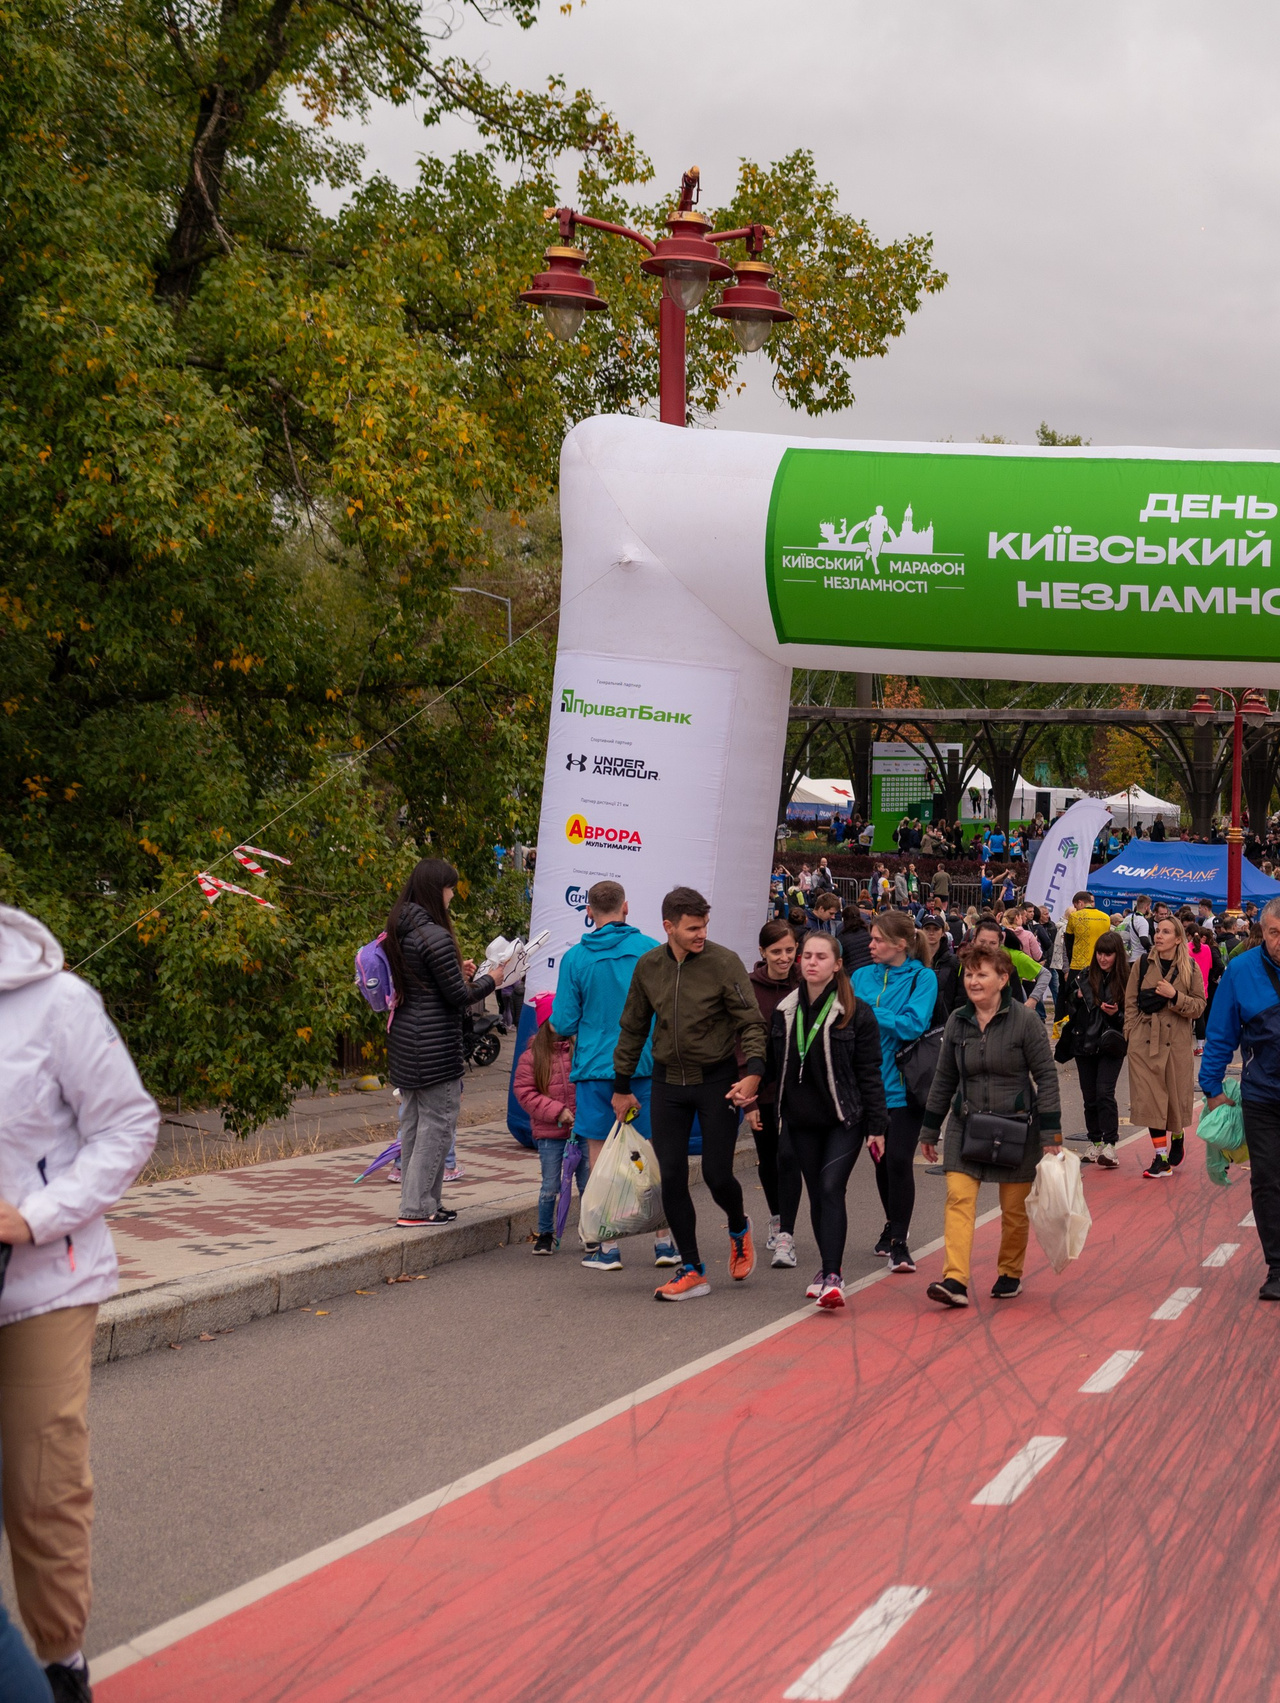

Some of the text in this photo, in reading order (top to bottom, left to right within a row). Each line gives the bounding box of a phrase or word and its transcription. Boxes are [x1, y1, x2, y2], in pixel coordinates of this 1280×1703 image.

[1139, 493, 1278, 523] ДЕНЬ
[988, 525, 1271, 567] КИЇВСЬКИЙ
[782, 553, 965, 576] КИЇВСЬКИЙ МАРАФОН
[823, 575, 928, 594] НЕЗЛАМНОСТІ
[596, 679, 623, 687] Генеральний
[573, 698, 693, 725] ПриватБанк
[590, 736, 614, 744] Спортивний
[594, 755, 645, 770] UNDER
[592, 765, 659, 781] ARMOUR
[585, 840, 642, 852] МУЛЬТИМАРКЕТ
